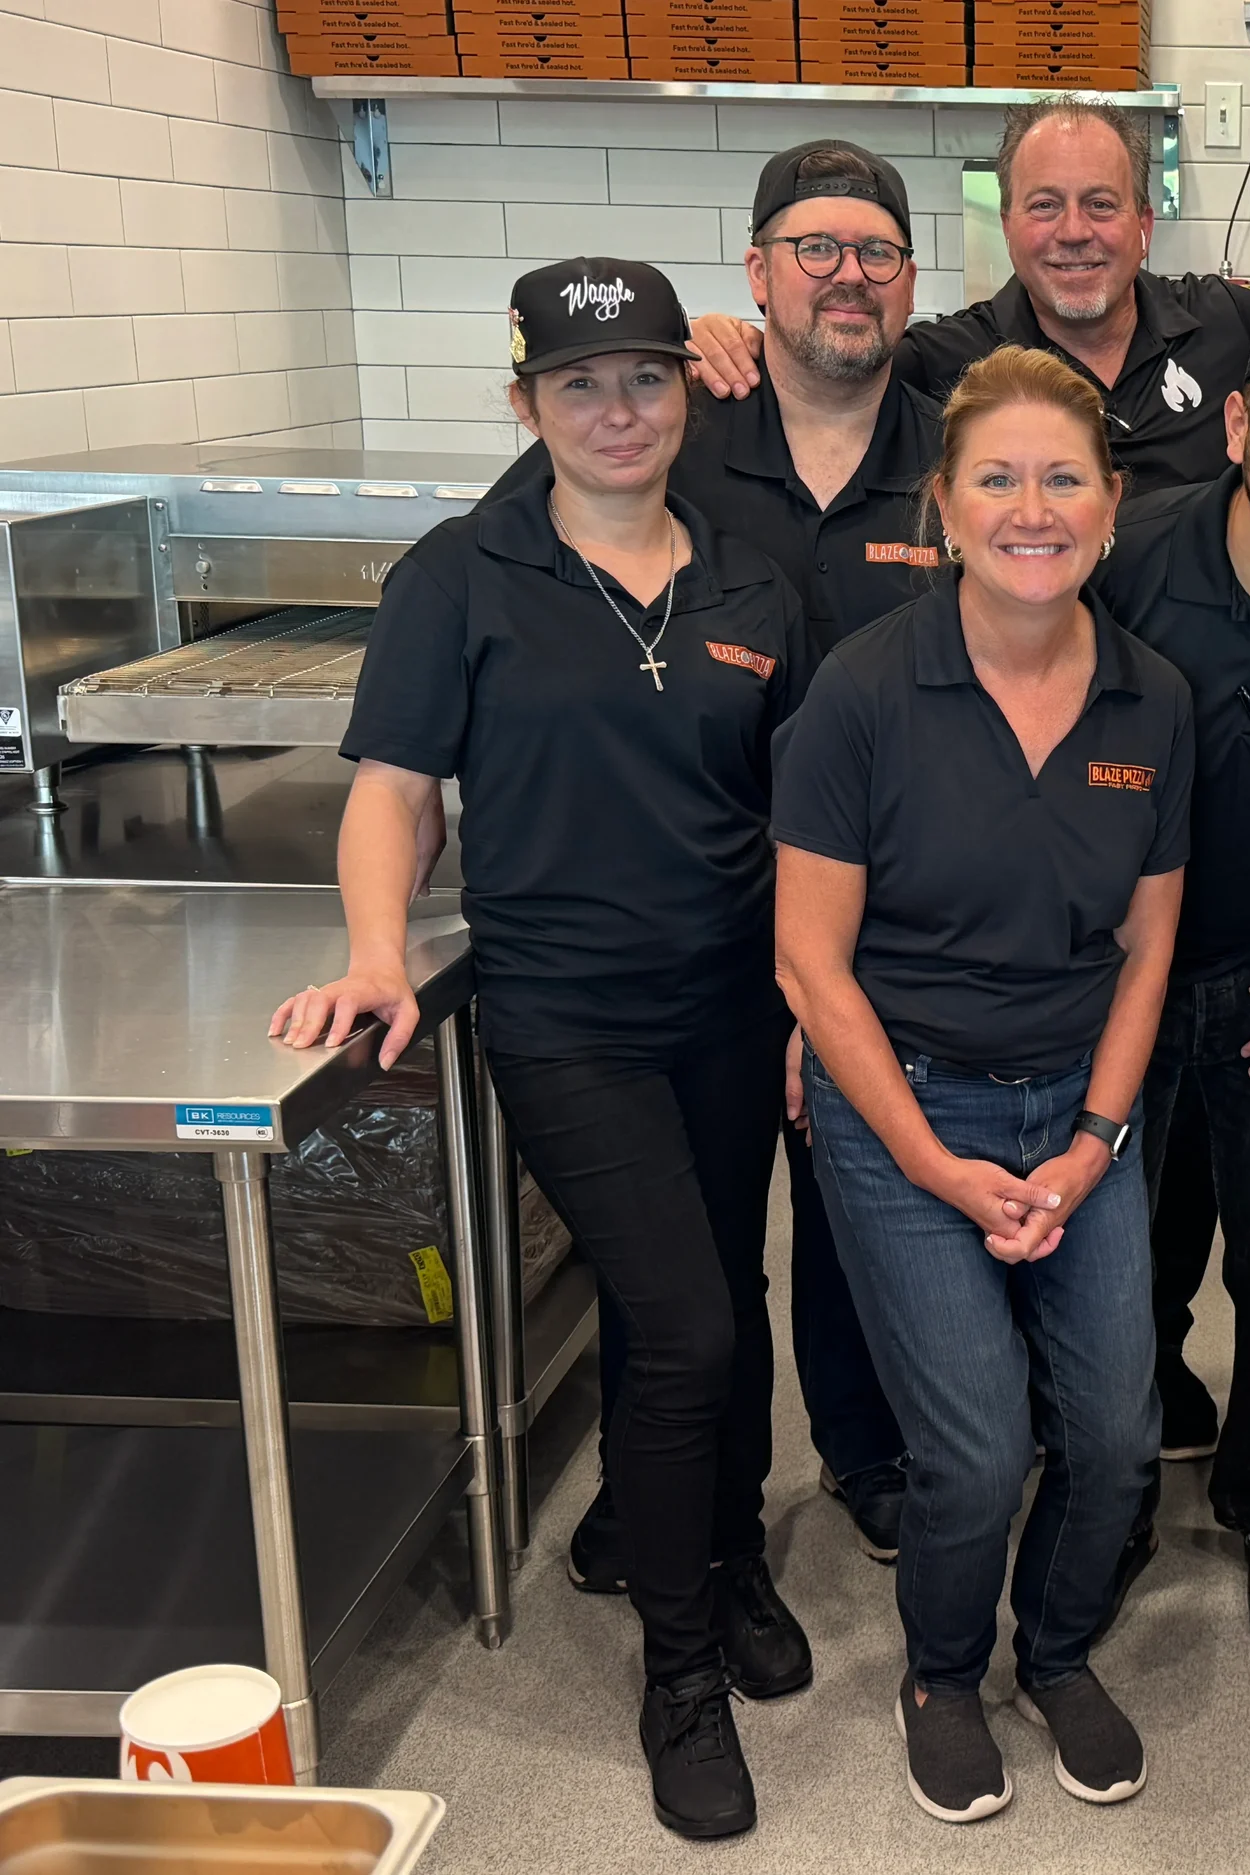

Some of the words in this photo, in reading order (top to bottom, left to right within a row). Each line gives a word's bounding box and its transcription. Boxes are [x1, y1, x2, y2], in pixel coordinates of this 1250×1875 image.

[559, 275, 635, 322] Waggle
[869, 544, 898, 560] BLAZE
[908, 548, 935, 564] PIZZA
[710, 644, 742, 664] BLAZE
[1092, 766, 1122, 782] BLAZE
